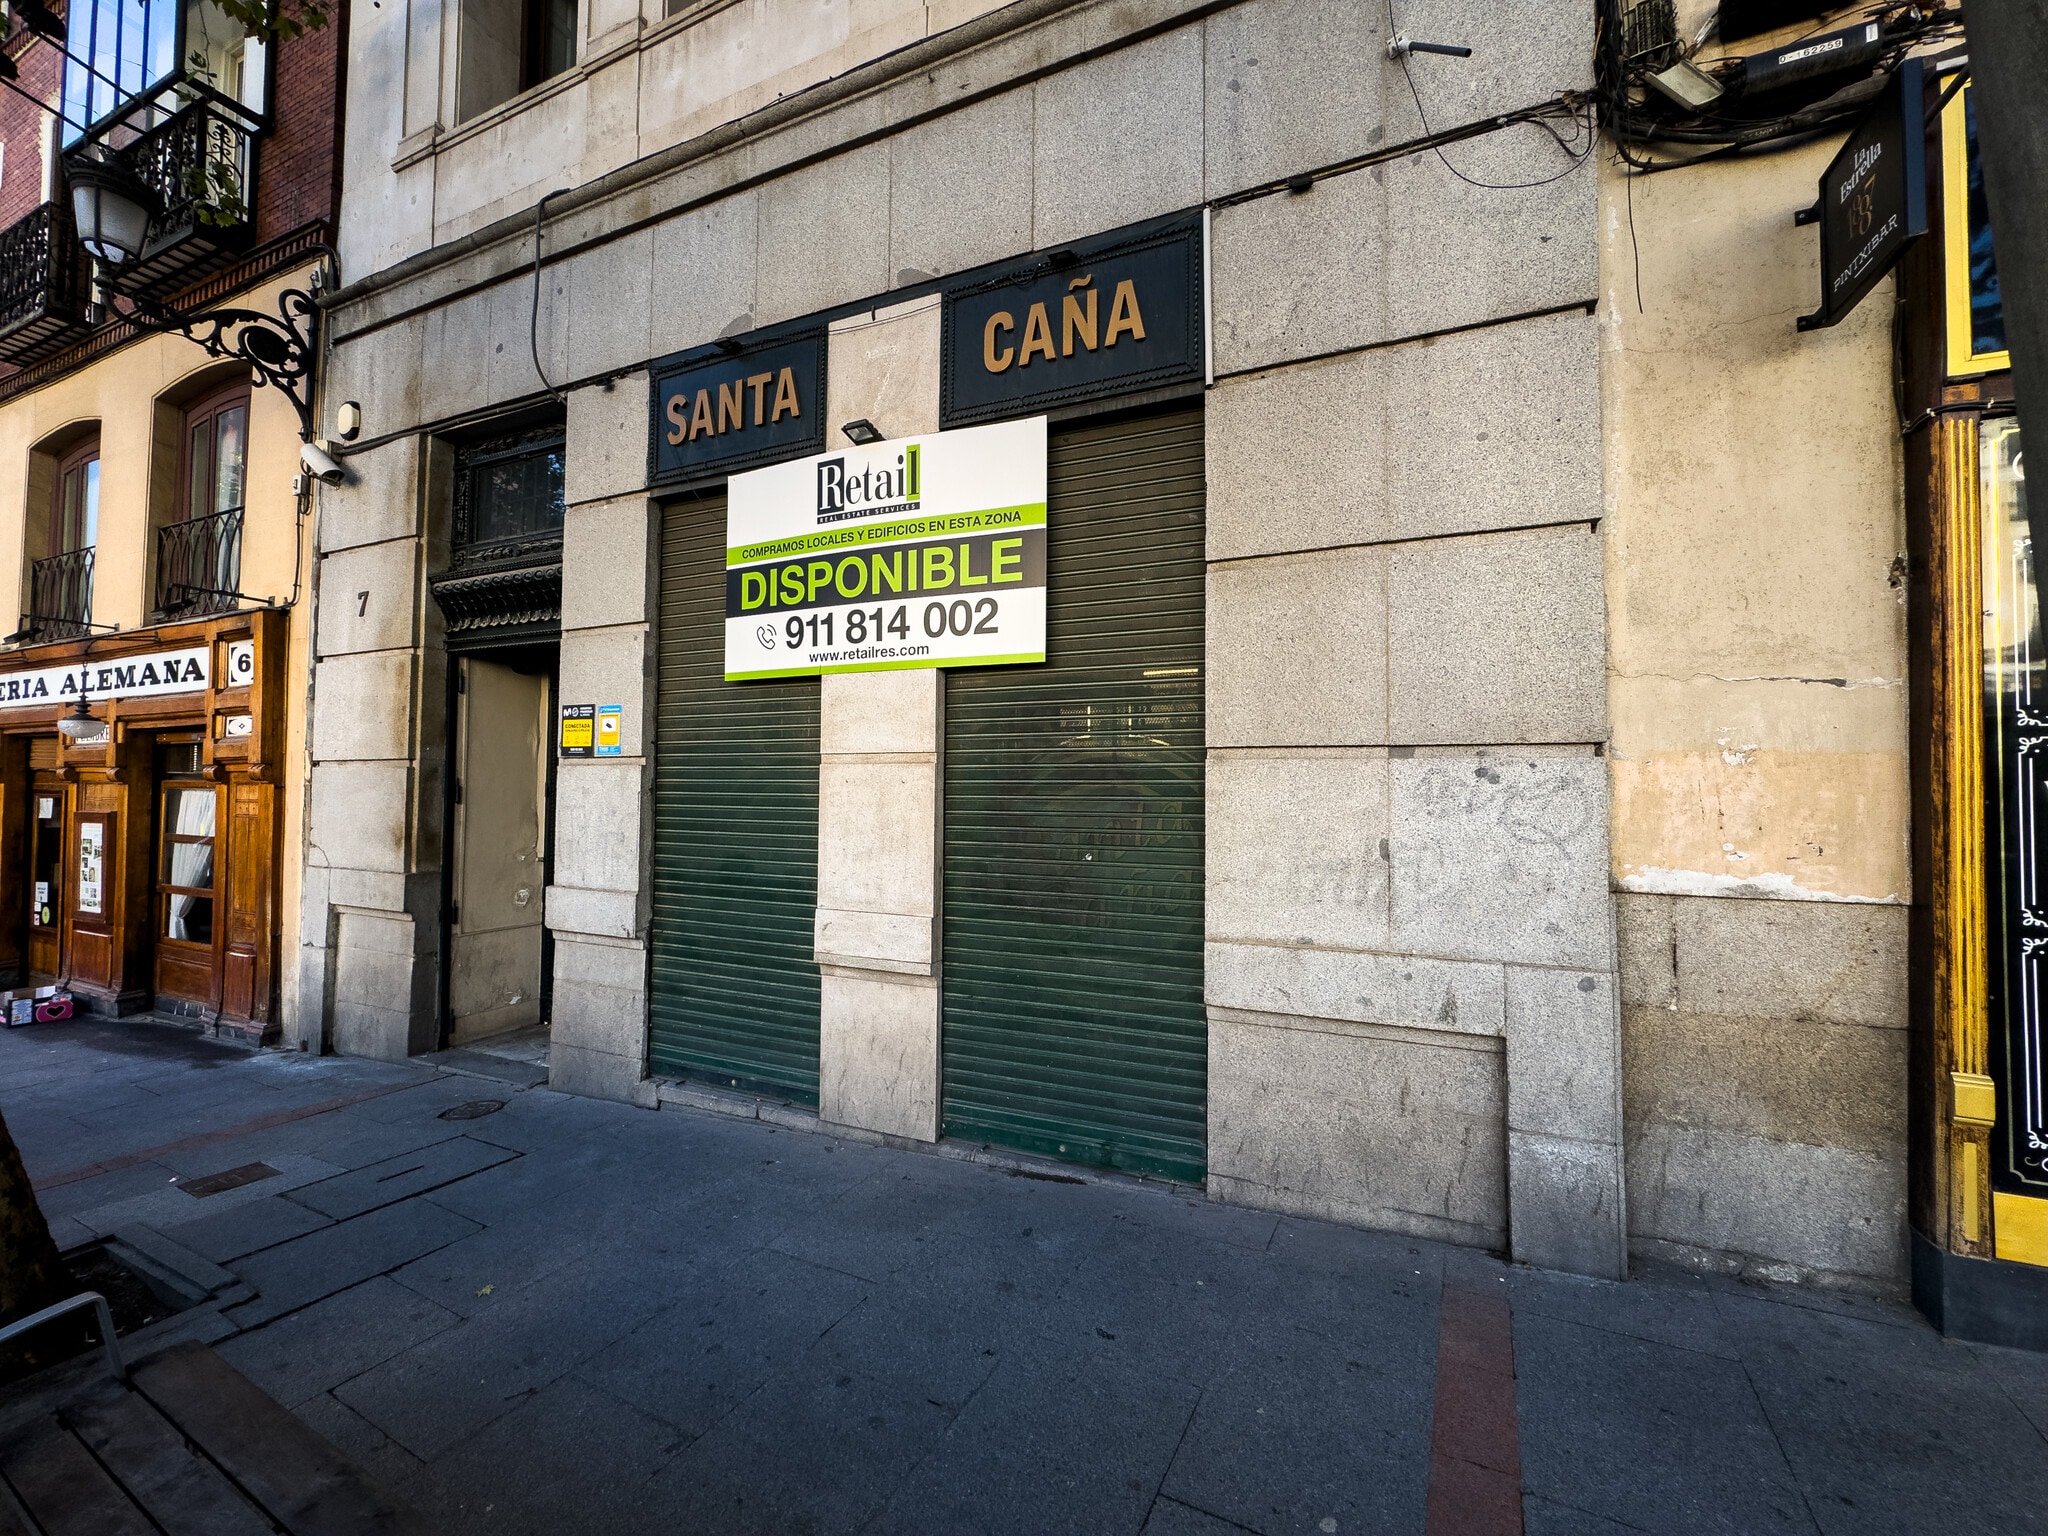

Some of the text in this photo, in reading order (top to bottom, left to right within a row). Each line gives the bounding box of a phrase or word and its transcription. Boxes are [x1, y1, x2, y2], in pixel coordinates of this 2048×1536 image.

[1840, 142, 1882, 205] Estrella
[1854, 148, 1866, 171] La
[1834, 213, 1899, 293] PINTXIBAR
[666, 273, 1147, 447] SANTA CAÑA
[819, 450, 919, 511] Retail
[742, 510, 1022, 559] COMPRAMOS LOCALES Y EDIFICIOS EN ESTA ZONA
[842, 510, 871, 519] ESTATE
[875, 503, 916, 514] SERVICES
[741, 537, 1024, 611] DISPONIBLE
[357, 590, 370, 617] 7
[785, 597, 999, 650] 911 814 002
[60, 657, 205, 695] ALEMANA
[238, 653, 251, 673] 6
[809, 643, 930, 663] www.retailres.com
